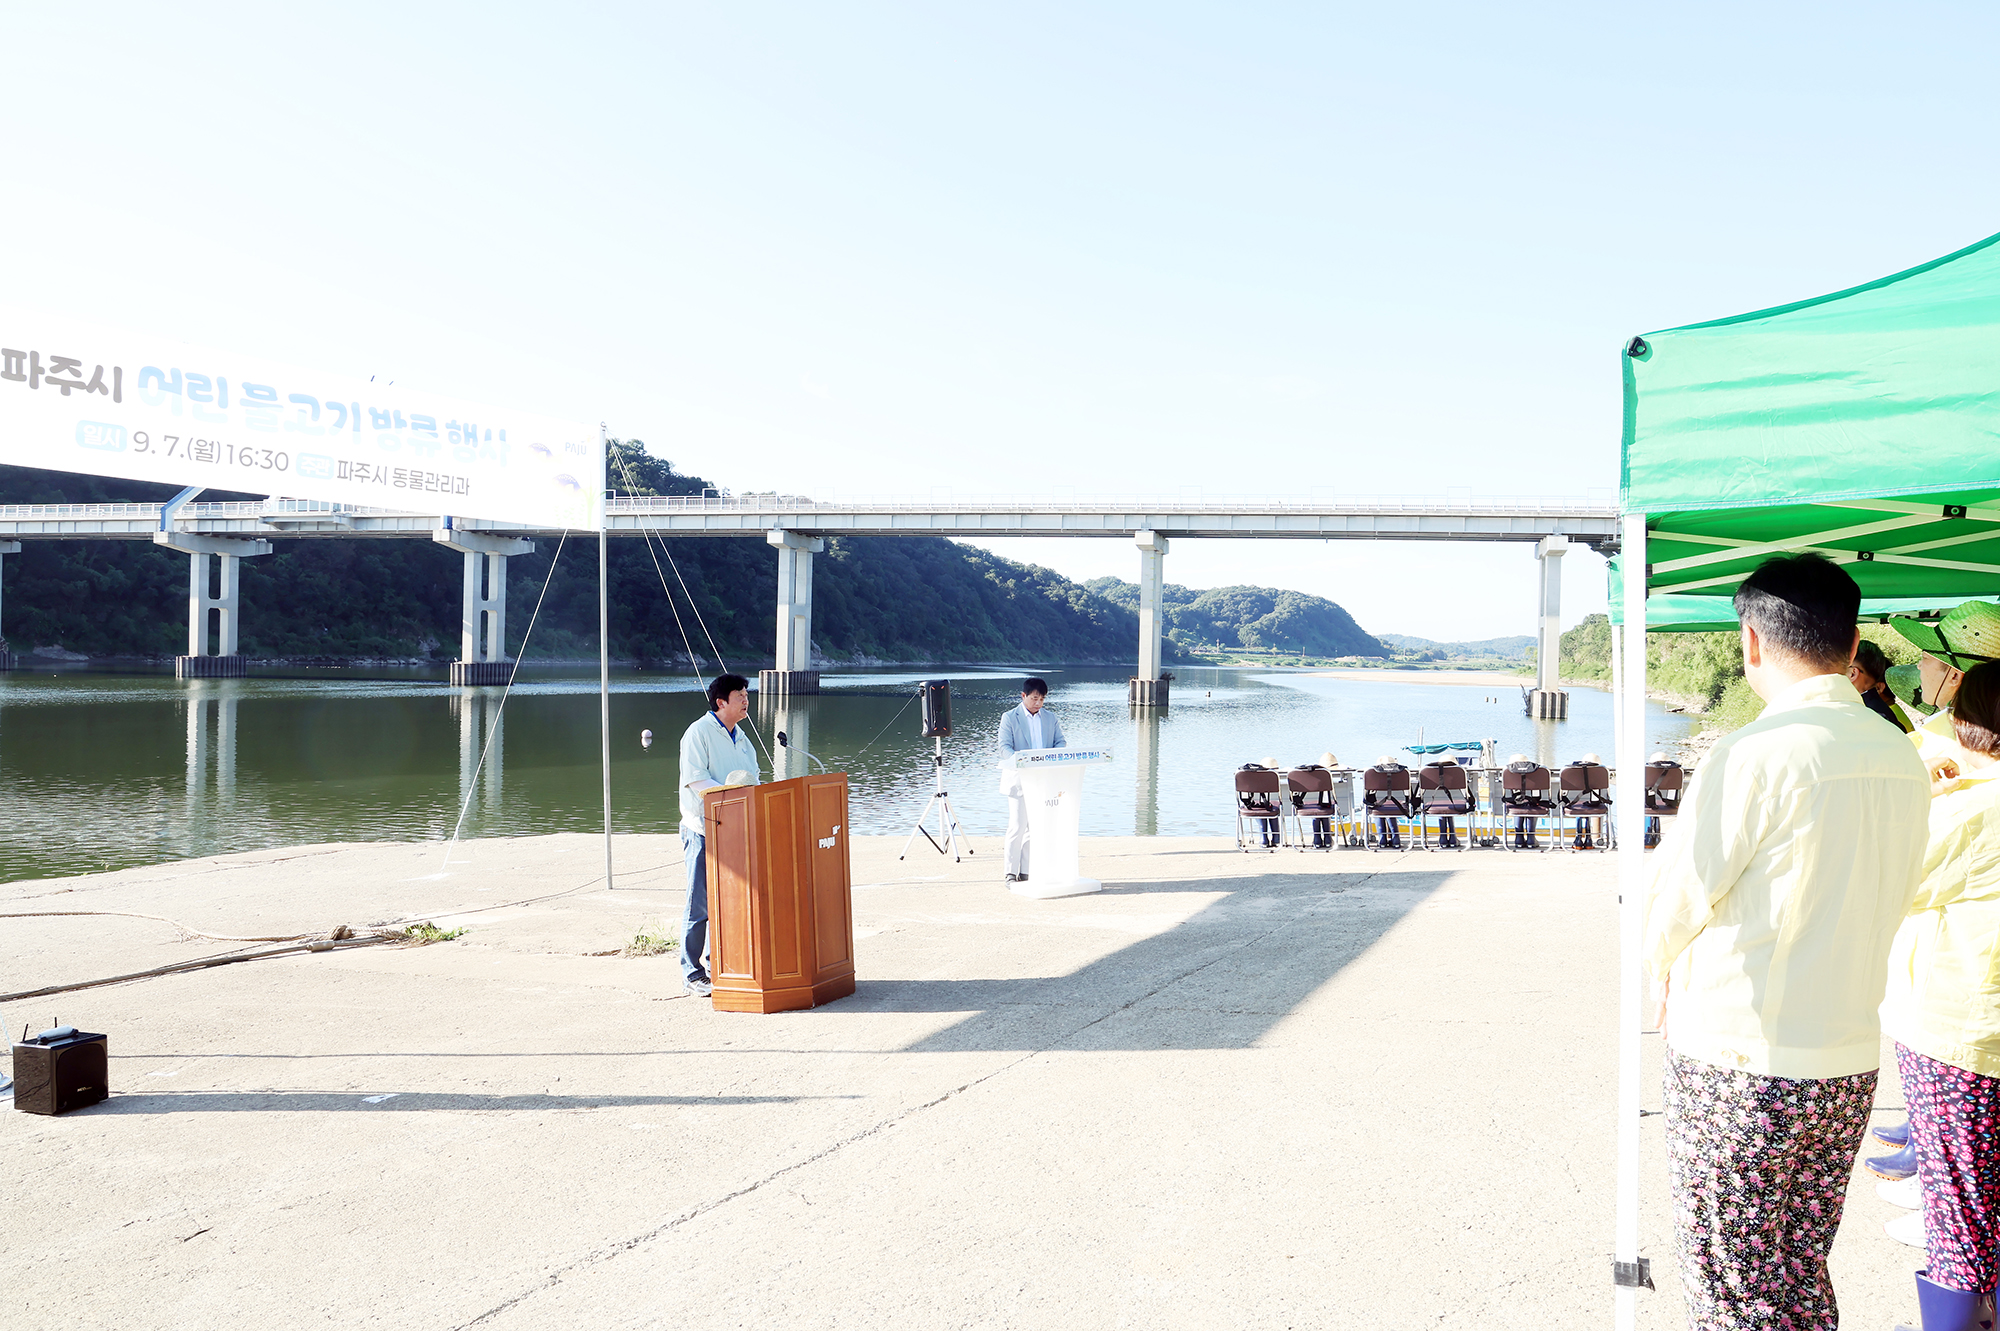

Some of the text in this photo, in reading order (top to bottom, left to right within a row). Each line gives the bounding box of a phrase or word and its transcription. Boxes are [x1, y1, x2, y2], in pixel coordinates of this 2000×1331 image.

[1, 347, 512, 468] 파주시 어린 물고기 방류 행사
[83, 424, 121, 449] 일시
[337, 460, 470, 496] 파주시 동물관리과
[818, 836, 836, 849] PAJU
